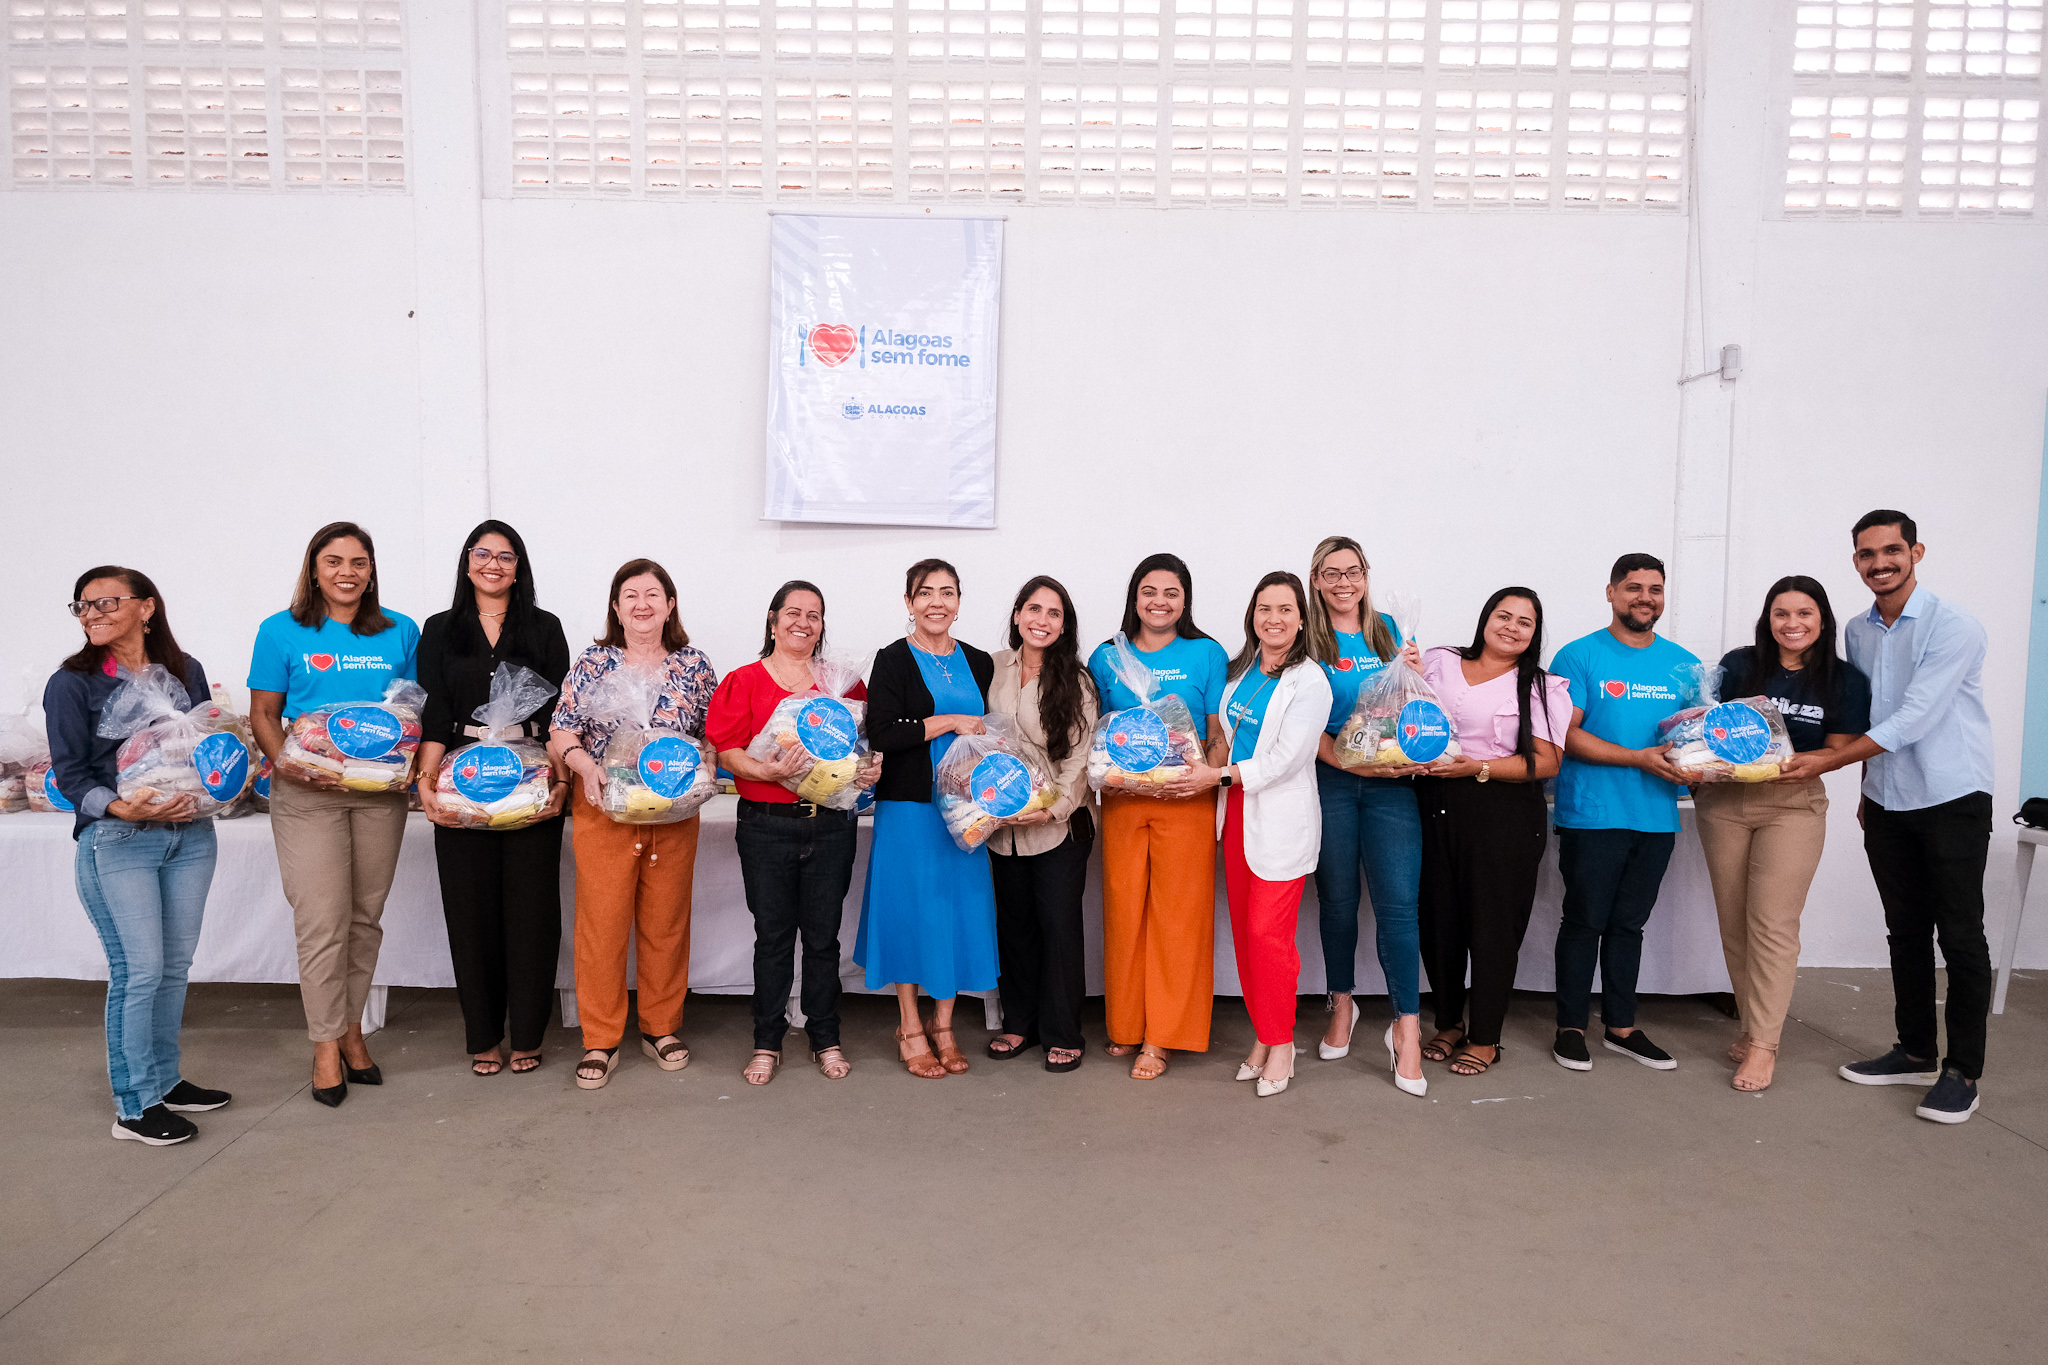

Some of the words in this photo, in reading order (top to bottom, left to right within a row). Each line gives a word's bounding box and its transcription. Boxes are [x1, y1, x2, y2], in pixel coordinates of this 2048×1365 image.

[871, 329, 953, 350] Alagoas
[871, 350, 914, 365] sem
[917, 349, 971, 367] fome
[867, 404, 926, 415] ALAGOAS
[342, 655, 384, 664] Alagoas
[343, 662, 366, 670] sem
[366, 661, 393, 671] fome
[1360, 662, 1379, 670] sem
[1152, 668, 1180, 677] lagoas
[1631, 683, 1668, 692] Alagoas
[1631, 691, 1651, 699] sem
[1652, 691, 1677, 700] fome
[1230, 701, 1254, 716] Alaas
[1770, 696, 1824, 720] tileza
[1241, 713, 1259, 725] ome
[360, 721, 392, 733] Alagoas
[1731, 724, 1758, 734] Alagoas
[376, 729, 396, 740] fome
[1131, 732, 1158, 741] Alagoas
[1746, 728, 1766, 737] fome
[1146, 739, 1164, 747] fome
[482, 764, 511, 772] Alagoas
[482, 769, 498, 777] sem
[996, 769, 1015, 787] Alagoas
[1000, 776, 1014, 792] sem
[1010, 769, 1024, 783] fome
